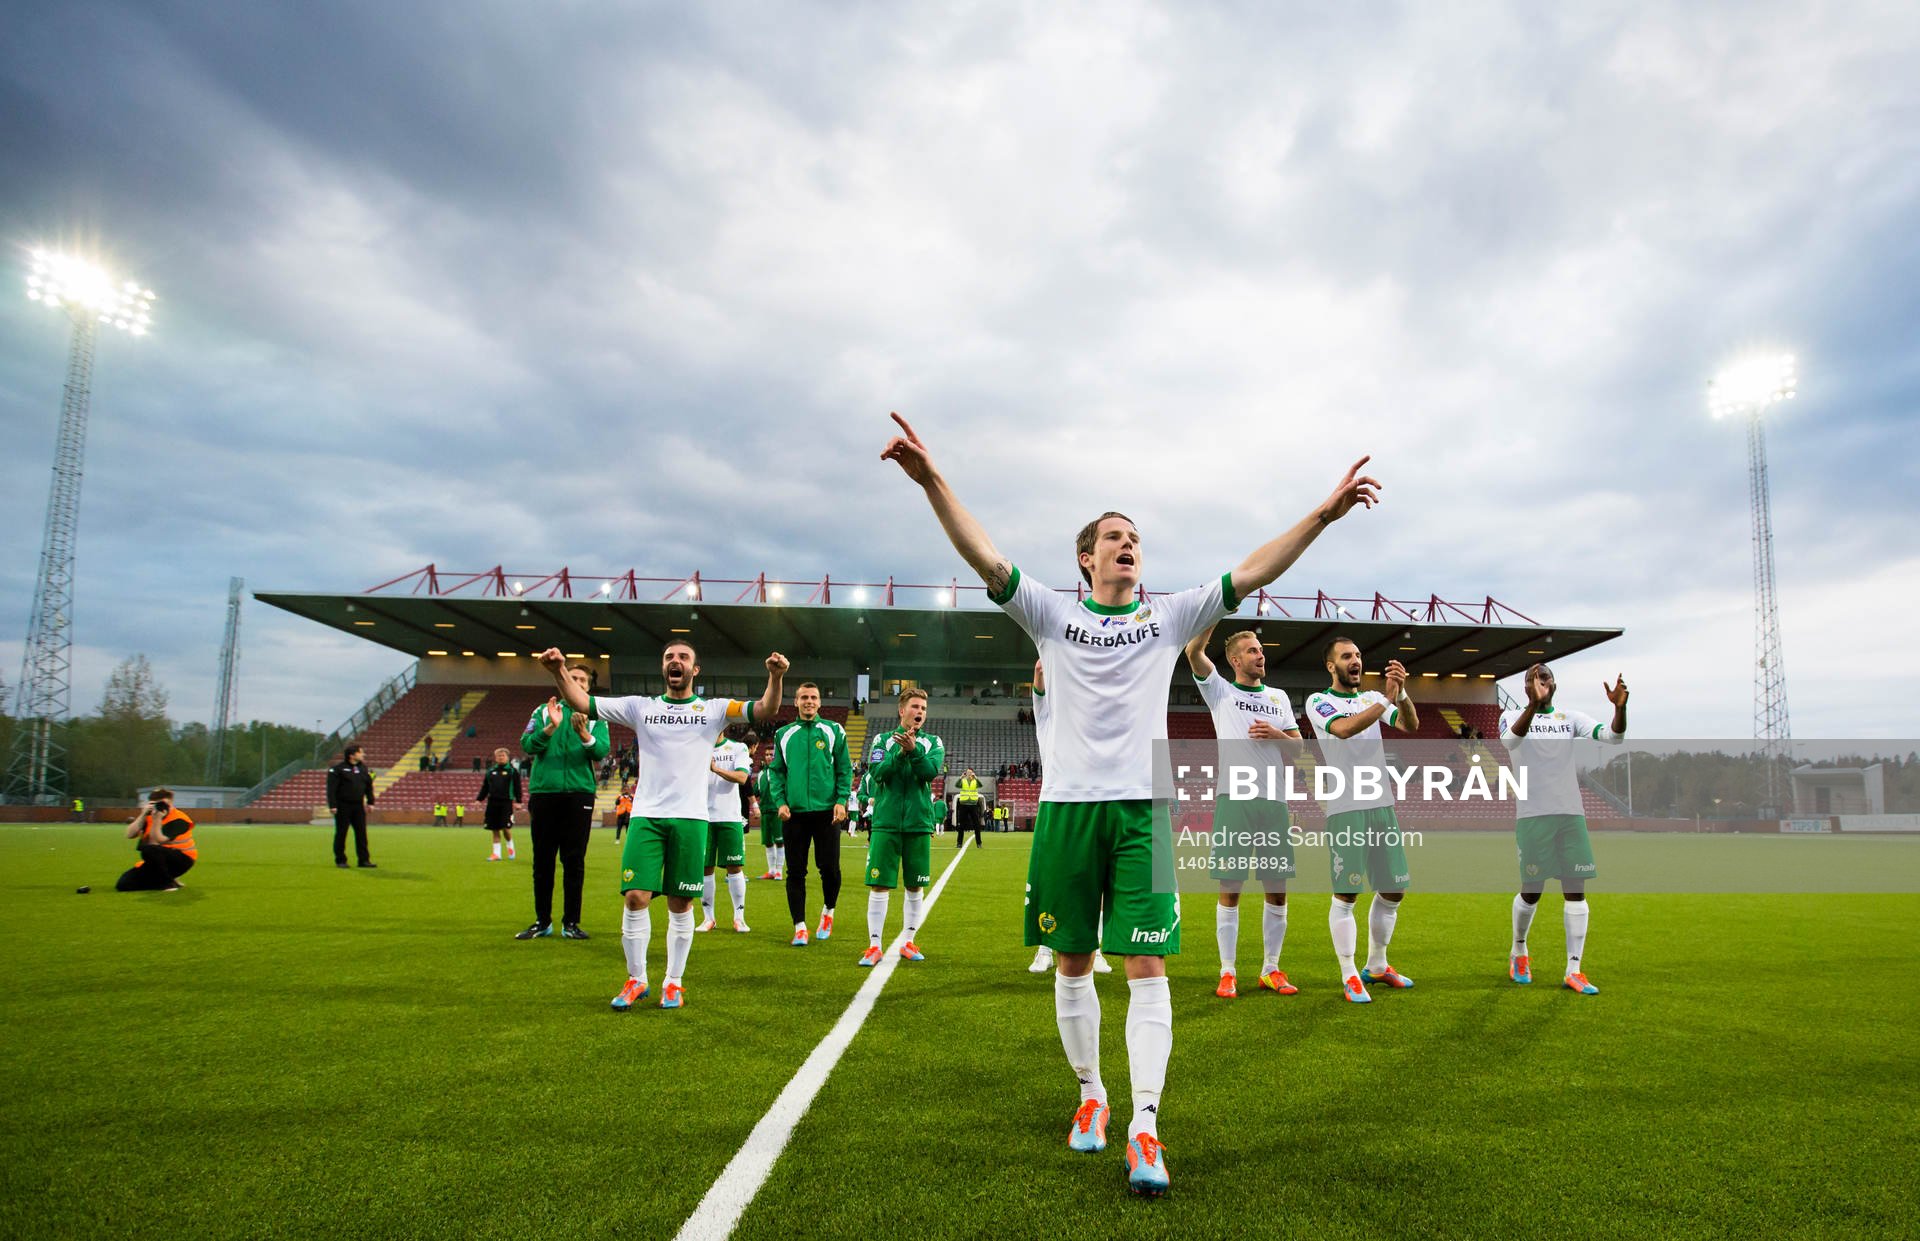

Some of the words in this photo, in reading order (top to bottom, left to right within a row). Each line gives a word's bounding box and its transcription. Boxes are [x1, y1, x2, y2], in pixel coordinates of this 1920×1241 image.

[1065, 622, 1160, 648] HERBALIFE
[644, 715, 707, 726] HERBALIFE
[1530, 724, 1571, 733] ERBALIFE
[1131, 927, 1171, 943] Inair
